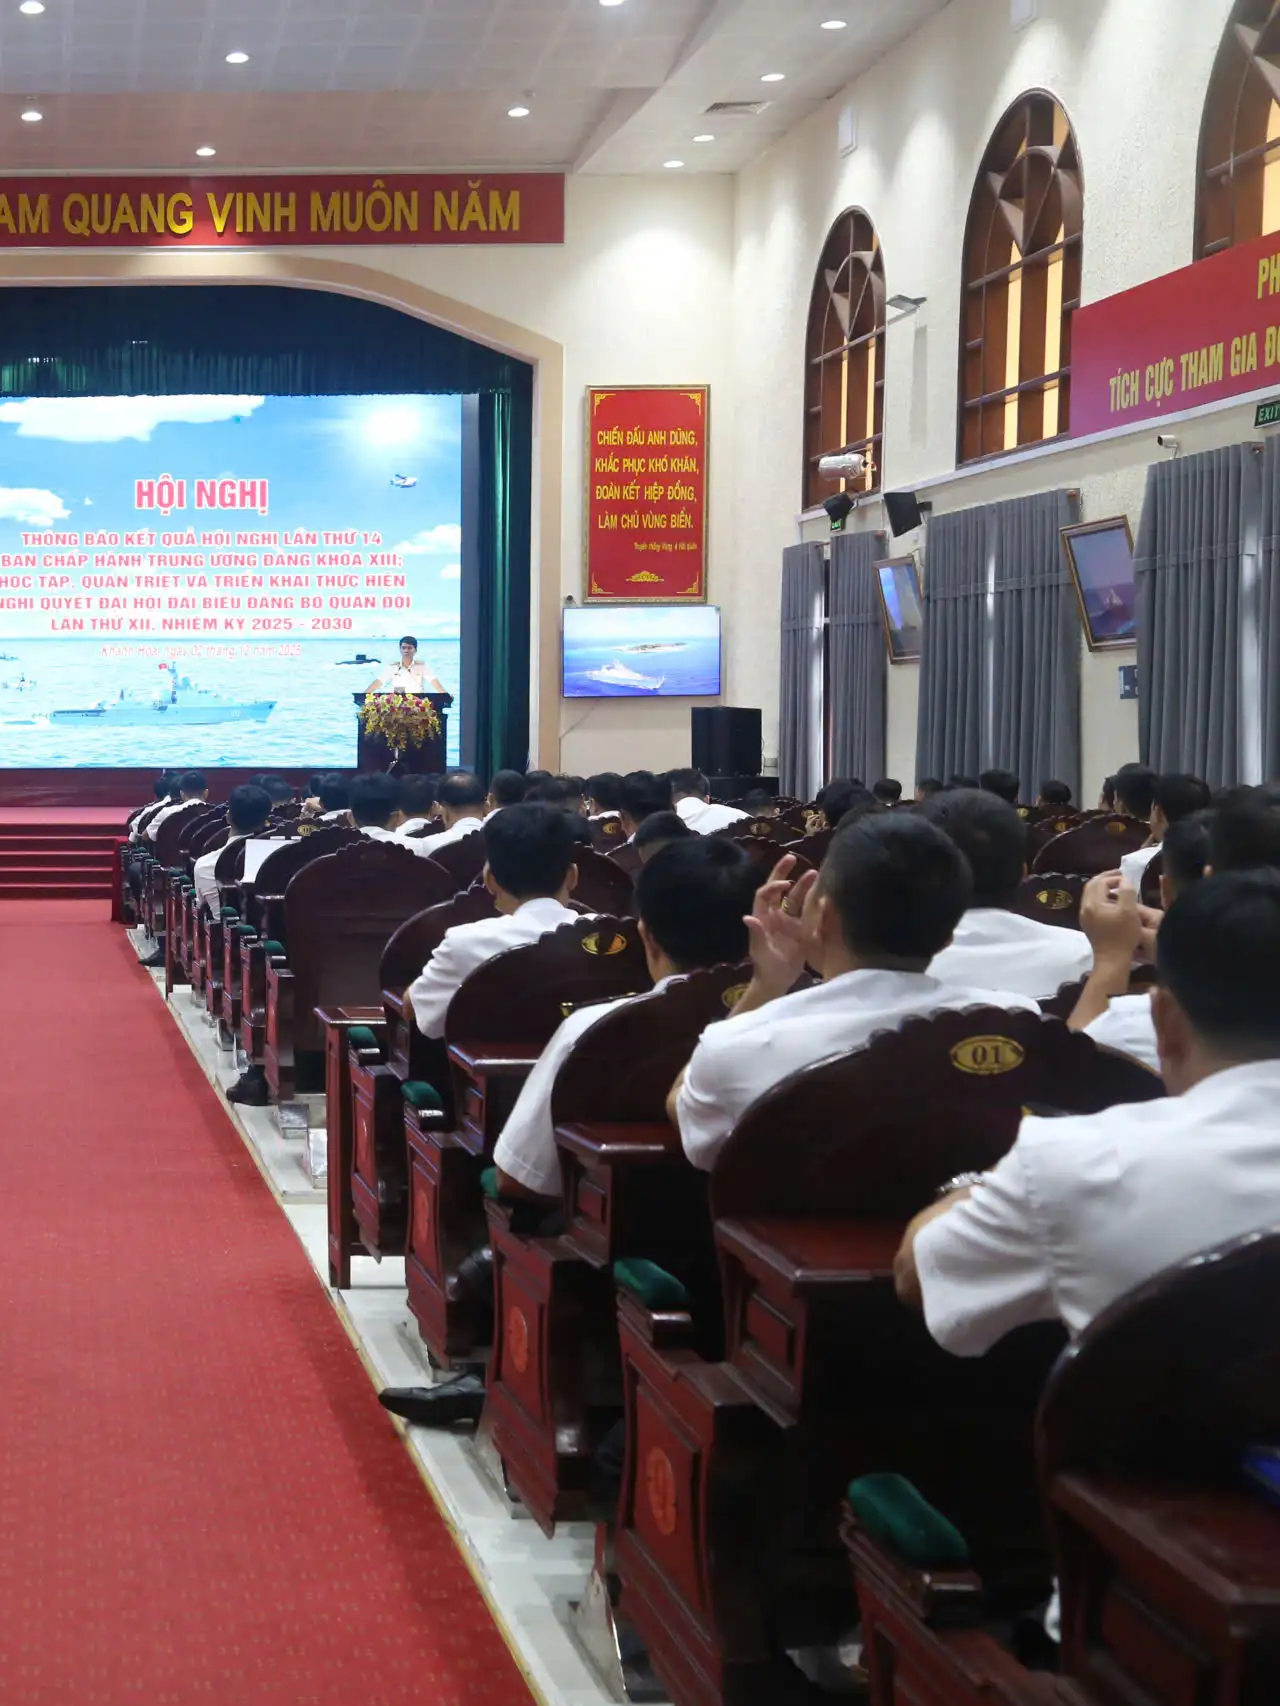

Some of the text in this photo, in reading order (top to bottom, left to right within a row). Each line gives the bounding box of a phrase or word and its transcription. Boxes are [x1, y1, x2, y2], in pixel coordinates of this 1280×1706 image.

[62, 192, 194, 237] QUANG
[207, 192, 296, 233] VINH
[310, 179, 419, 233] MUÔN
[434, 180, 520, 233] NĂM
[1109, 368, 1140, 412] TÍCH
[1145, 357, 1174, 407] CỰC
[1180, 342, 1224, 391] THAM
[1230, 332, 1257, 377] GIA
[597, 425, 624, 445] CHIẾN
[626, 425, 645, 445] ĐẤU
[647, 431, 666, 445] ANH
[595, 452, 619, 473] KHẮC
[623, 458, 646, 476] PHỤC
[649, 454, 668, 473] KHÓ
[136, 474, 268, 514] HỘI NGHỊ
[596, 482, 620, 500] ĐOÀN
[623, 479, 640, 500] KẾT
[644, 481, 664, 503] HIỆP
[599, 510, 617, 529] LÀM
[621, 510, 639, 528] CHỦ
[642, 510, 666, 528] VÙNG
[362, 532, 382, 545] 14
[1, 554, 37, 567] BAN
[148, 554, 204, 567] TRUNG
[269, 575, 310, 588] KHAI
[252, 617, 293, 630] 2025
[312, 617, 353, 630] 2030
[971, 1045, 1003, 1067] 01
